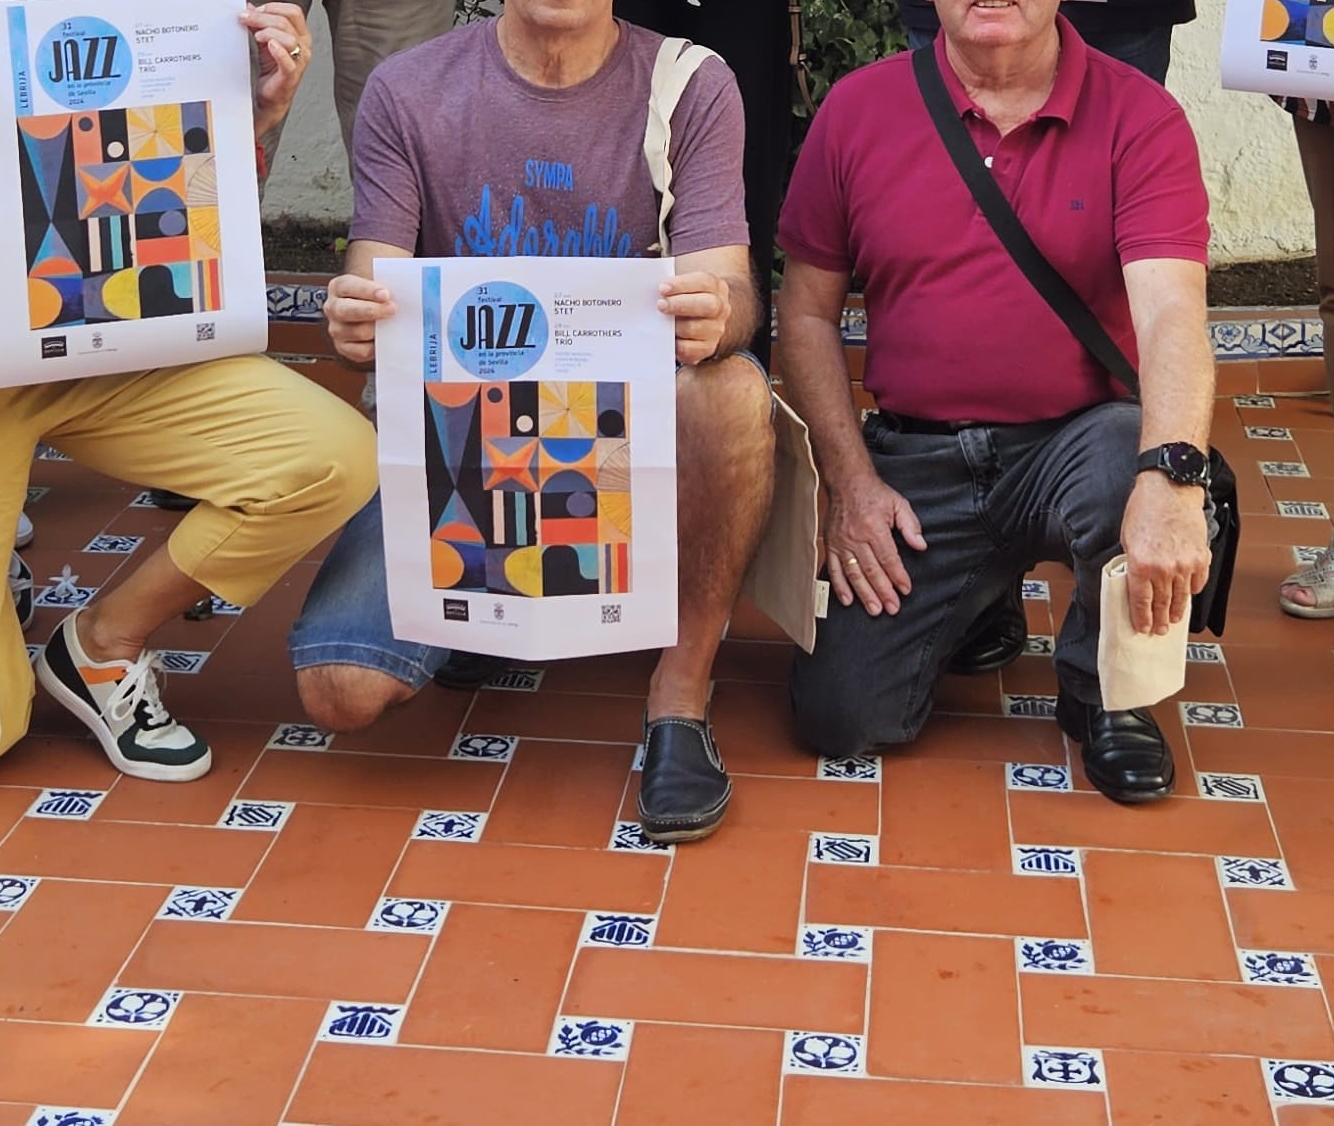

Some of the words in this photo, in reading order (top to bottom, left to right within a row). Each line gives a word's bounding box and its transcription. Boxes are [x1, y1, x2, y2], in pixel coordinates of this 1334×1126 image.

[49, 36, 122, 83] JAZZ
[525, 158, 574, 192] SYMPA
[460, 304, 536, 350] JAZZ
[429, 333, 437, 374] LEBRIJA
